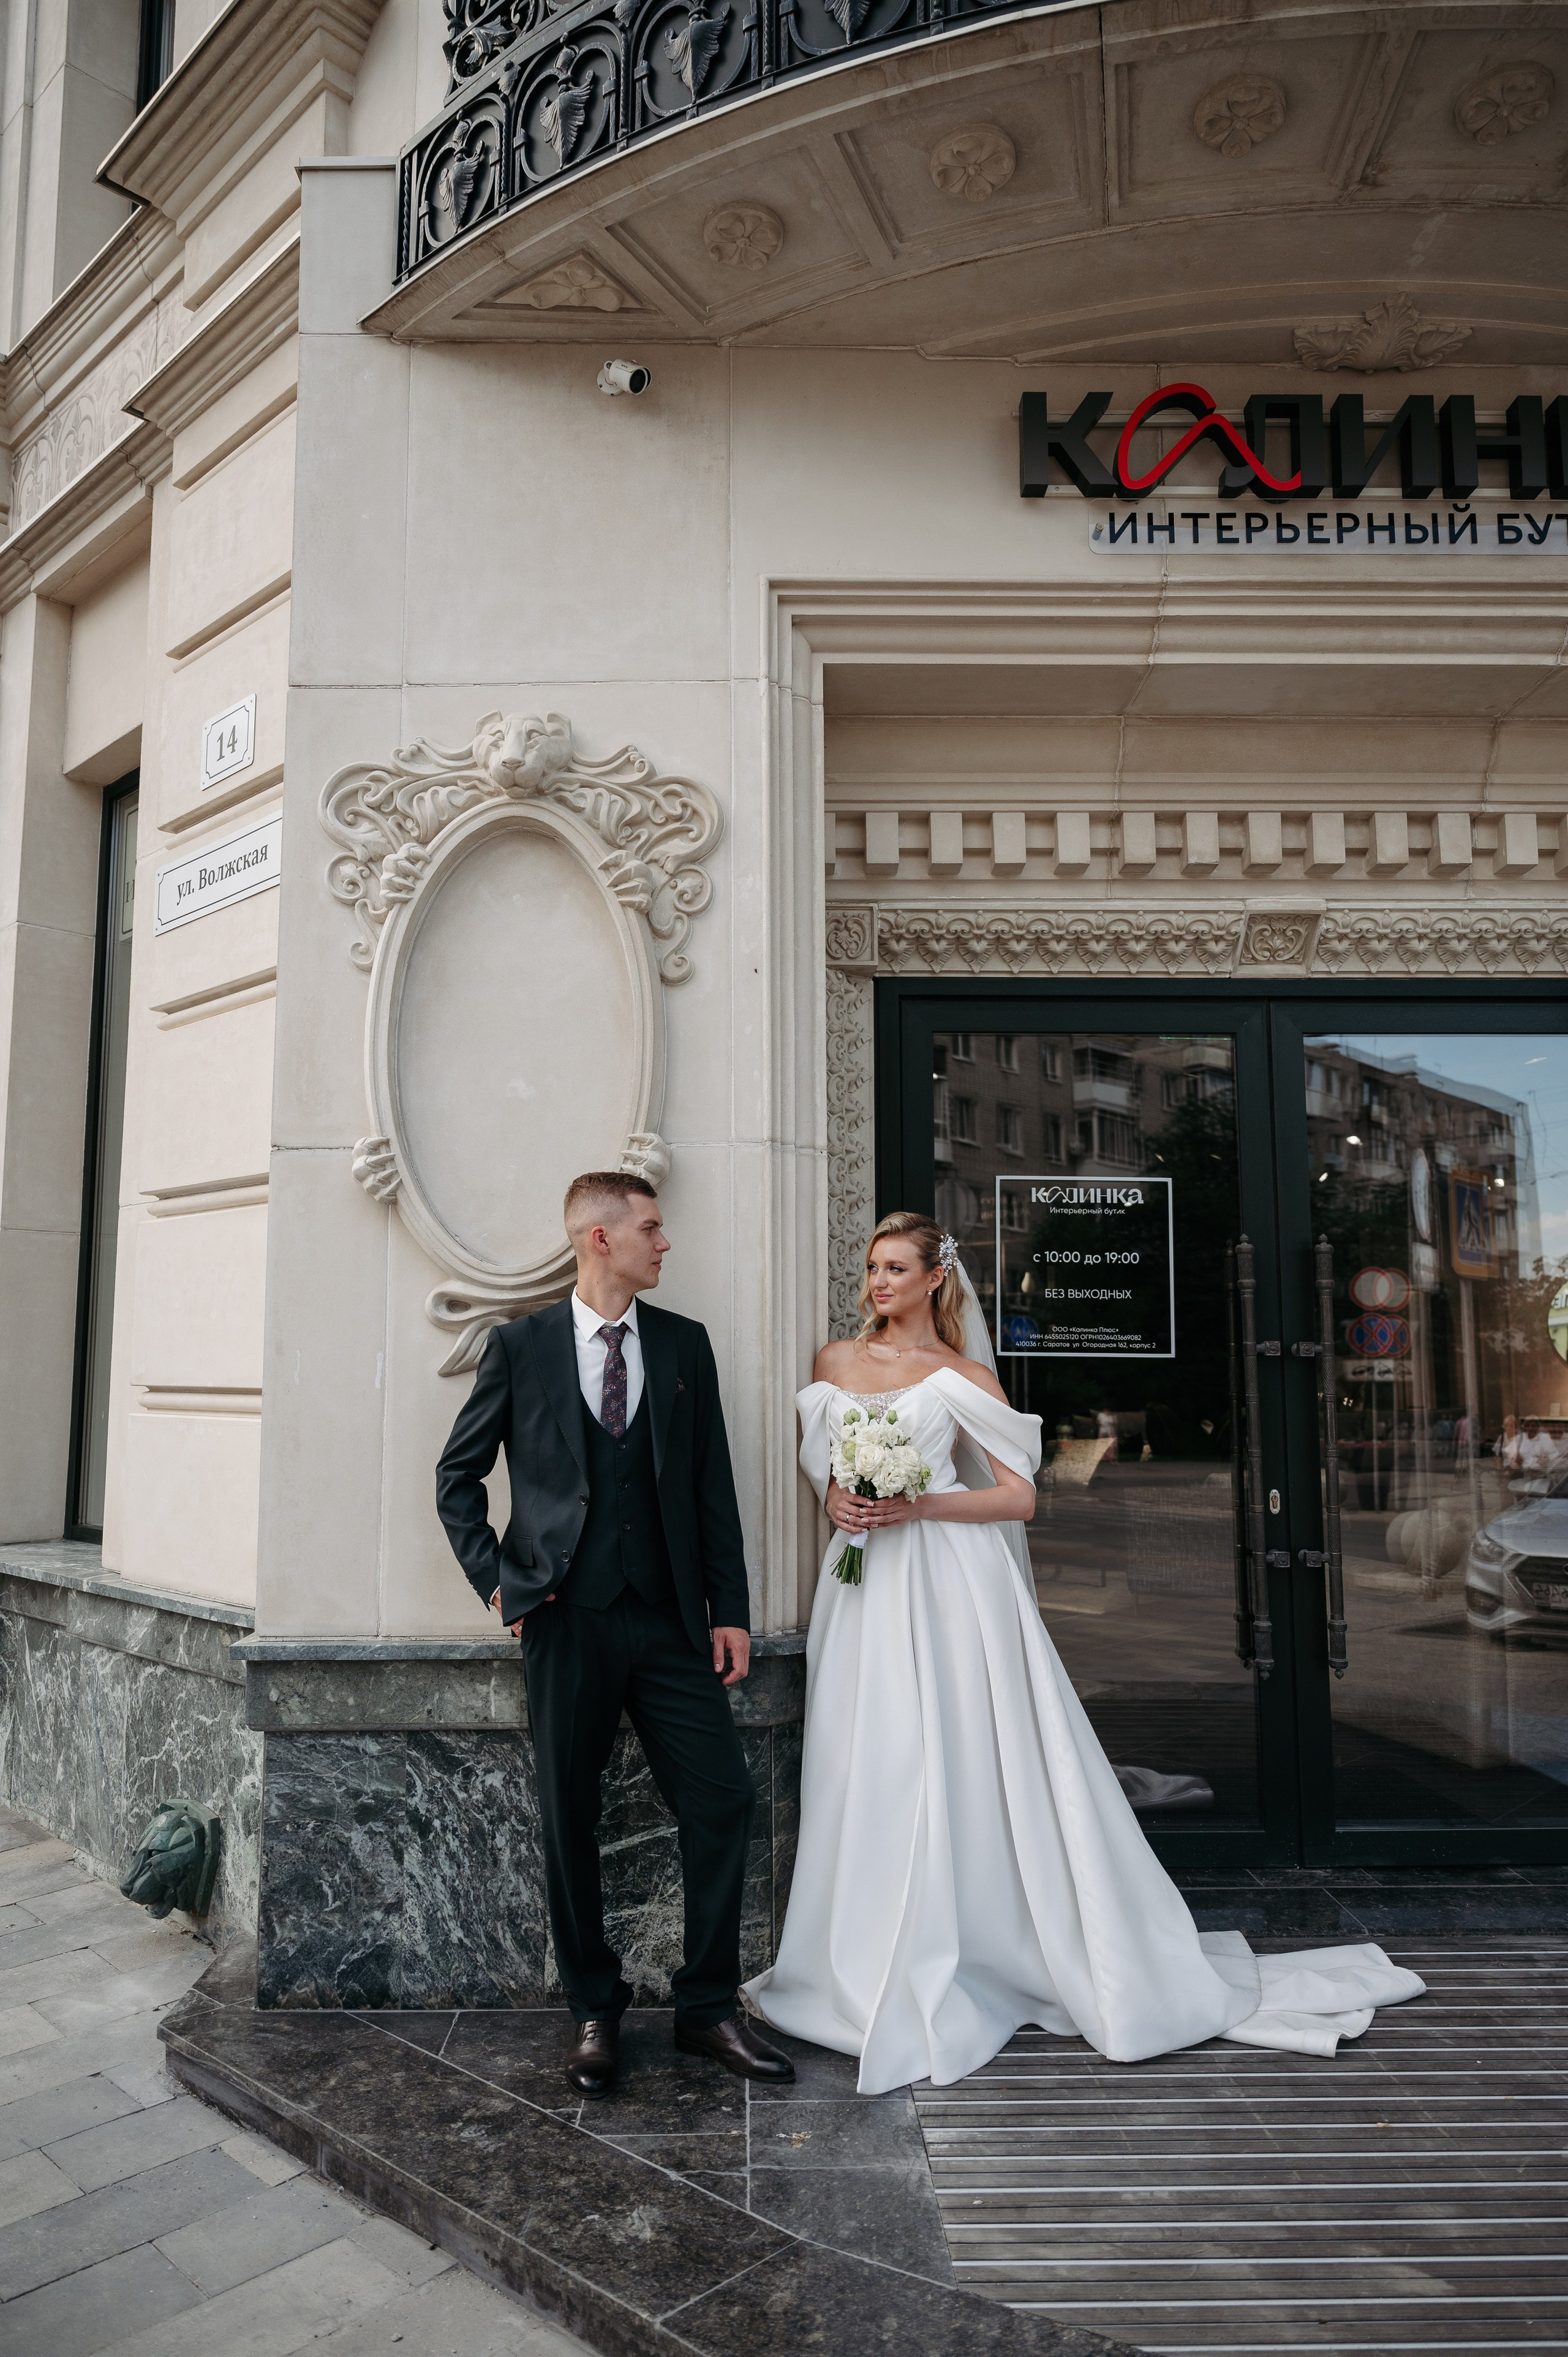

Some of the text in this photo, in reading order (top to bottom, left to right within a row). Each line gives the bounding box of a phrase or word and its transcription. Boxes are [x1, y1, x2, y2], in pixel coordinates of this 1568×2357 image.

[1019, 382, 1568, 503] КАЛИН
[1109, 503, 1478, 545] ИНТЕРЬЕРНЫЙ
[217, 725, 238, 761] 14
[176, 844, 268, 906] ул. Волжская
[1050, 1207, 1102, 1215] Интерьерный
[1044, 1251, 1080, 1263] 10:00
[1084, 1254, 1101, 1265] до
[1104, 1252, 1140, 1264] 19:00
[1045, 1289, 1132, 1300] БЕЗ ВЫХОДНЫХ
